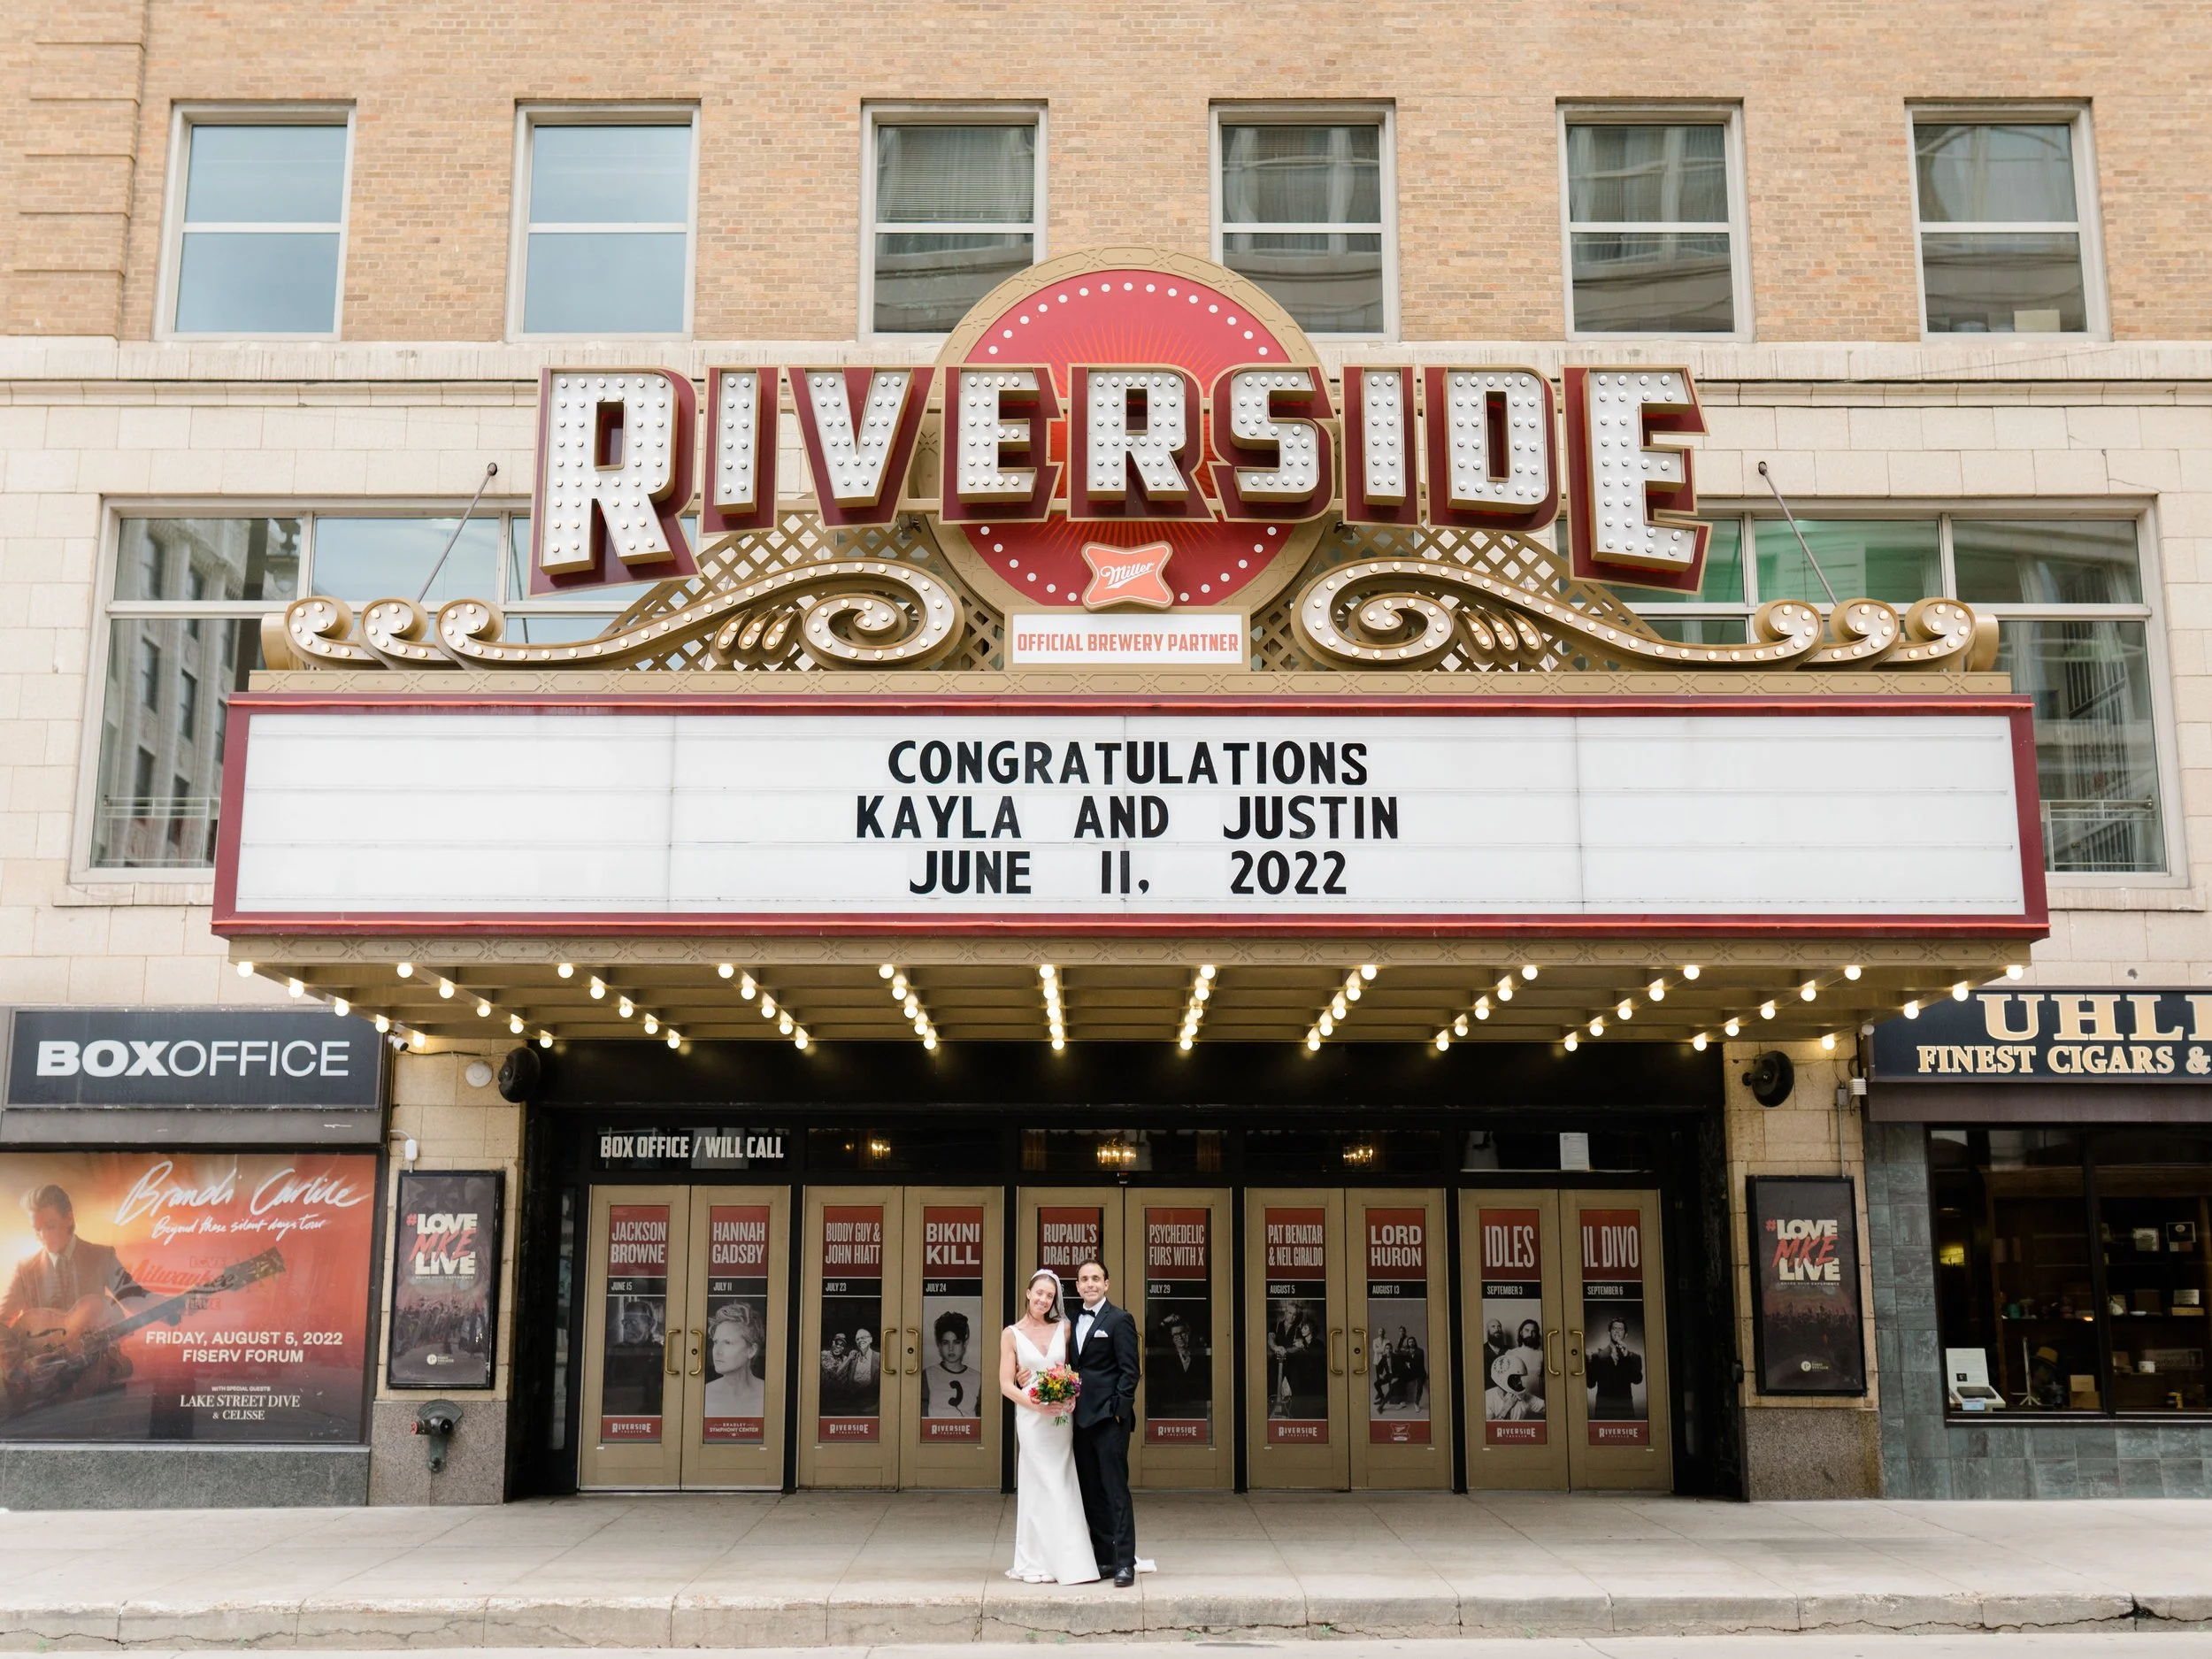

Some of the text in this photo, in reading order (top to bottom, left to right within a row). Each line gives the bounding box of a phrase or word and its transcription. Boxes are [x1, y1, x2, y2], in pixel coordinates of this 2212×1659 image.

[536, 365, 1702, 580] RIVERSIDE
[1100, 561, 1156, 585] Miller
[1018, 634, 1239, 651] OFFICIAL BREWERY PARTNER
[887, 740, 1368, 786] CONGRATULATIONS
[856, 795, 1399, 840] KAYLA AND JUSTIN
[909, 850, 1032, 895] JUNE
[1230, 850, 1348, 895] 2022
[1916, 1045, 2211, 1074] FINEST CIGARS &
[600, 1136, 784, 1158] BOX OFFICE / WILL CALL
[114, 1160, 242, 1226] Brandi
[151, 1214, 326, 1245] Beyond these silent days tour
[611, 1222, 666, 1240] JACKSON
[713, 1222, 765, 1241] HANNAH
[826, 1223, 881, 1242] BUDDY GUY &
[926, 1223, 979, 1242] BIKINI
[1043, 1224, 1097, 1243] RUPAUL'S
[1149, 1225, 1204, 1244] PSYCHEDELIC
[1268, 1225, 1323, 1244] PAT BENATAR
[1371, 1225, 1422, 1245] LORD
[409, 1228, 478, 1263] MKE
[611, 1244, 664, 1263] BROWNE
[712, 1244, 764, 1263] GADSBY
[826, 1245, 880, 1264] JOHN HIATT
[926, 1245, 979, 1264] KILL
[1485, 1225, 1534, 1268] IDLES
[1583, 1225, 1639, 1268] IL DIVO
[1771, 1234, 1838, 1268] MKE
[415, 1251, 476, 1274] LIVE
[1043, 1246, 1097, 1265] DRAG RACE
[1149, 1246, 1204, 1266] FURS WITH X
[1268, 1247, 1323, 1266] & NEIL GIRALDO
[1371, 1247, 1422, 1267] HURON
[1778, 1257, 1840, 1281] LIVE
[611, 1282, 633, 1291] JUNE 15
[713, 1282, 726, 1291] JULY
[826, 1283, 847, 1292] JULY 23
[926, 1283, 947, 1292] JULY 24
[1149, 1285, 1171, 1294] JULY 29
[1270, 1285, 1295, 1294] AUGUST 5
[1372, 1286, 1400, 1294] AUGUST 13
[1486, 1286, 1523, 1294] SEPTEMBER 3
[1587, 1286, 1624, 1295] SEPTEMBER 6
[145, 1331, 343, 1346] FRIDAY, AUGUST 5, 2022
[182, 1349, 303, 1363] FISERV FORUM
[180, 1395, 300, 1408] LAKE STREET DIVE
[222, 1410, 265, 1420] CELISSE
[612, 1423, 651, 1433] RIVERSIDE
[830, 1424, 869, 1433] RIVERSIDE
[932, 1425, 971, 1434] RIVERSIDE
[1158, 1426, 1196, 1436] RIVERSIDE
[1279, 1427, 1317, 1436] RIVERSIDE
[1497, 1428, 1536, 1438] RIVERSIDE
[1600, 1428, 1638, 1438] RIVERSIDE
